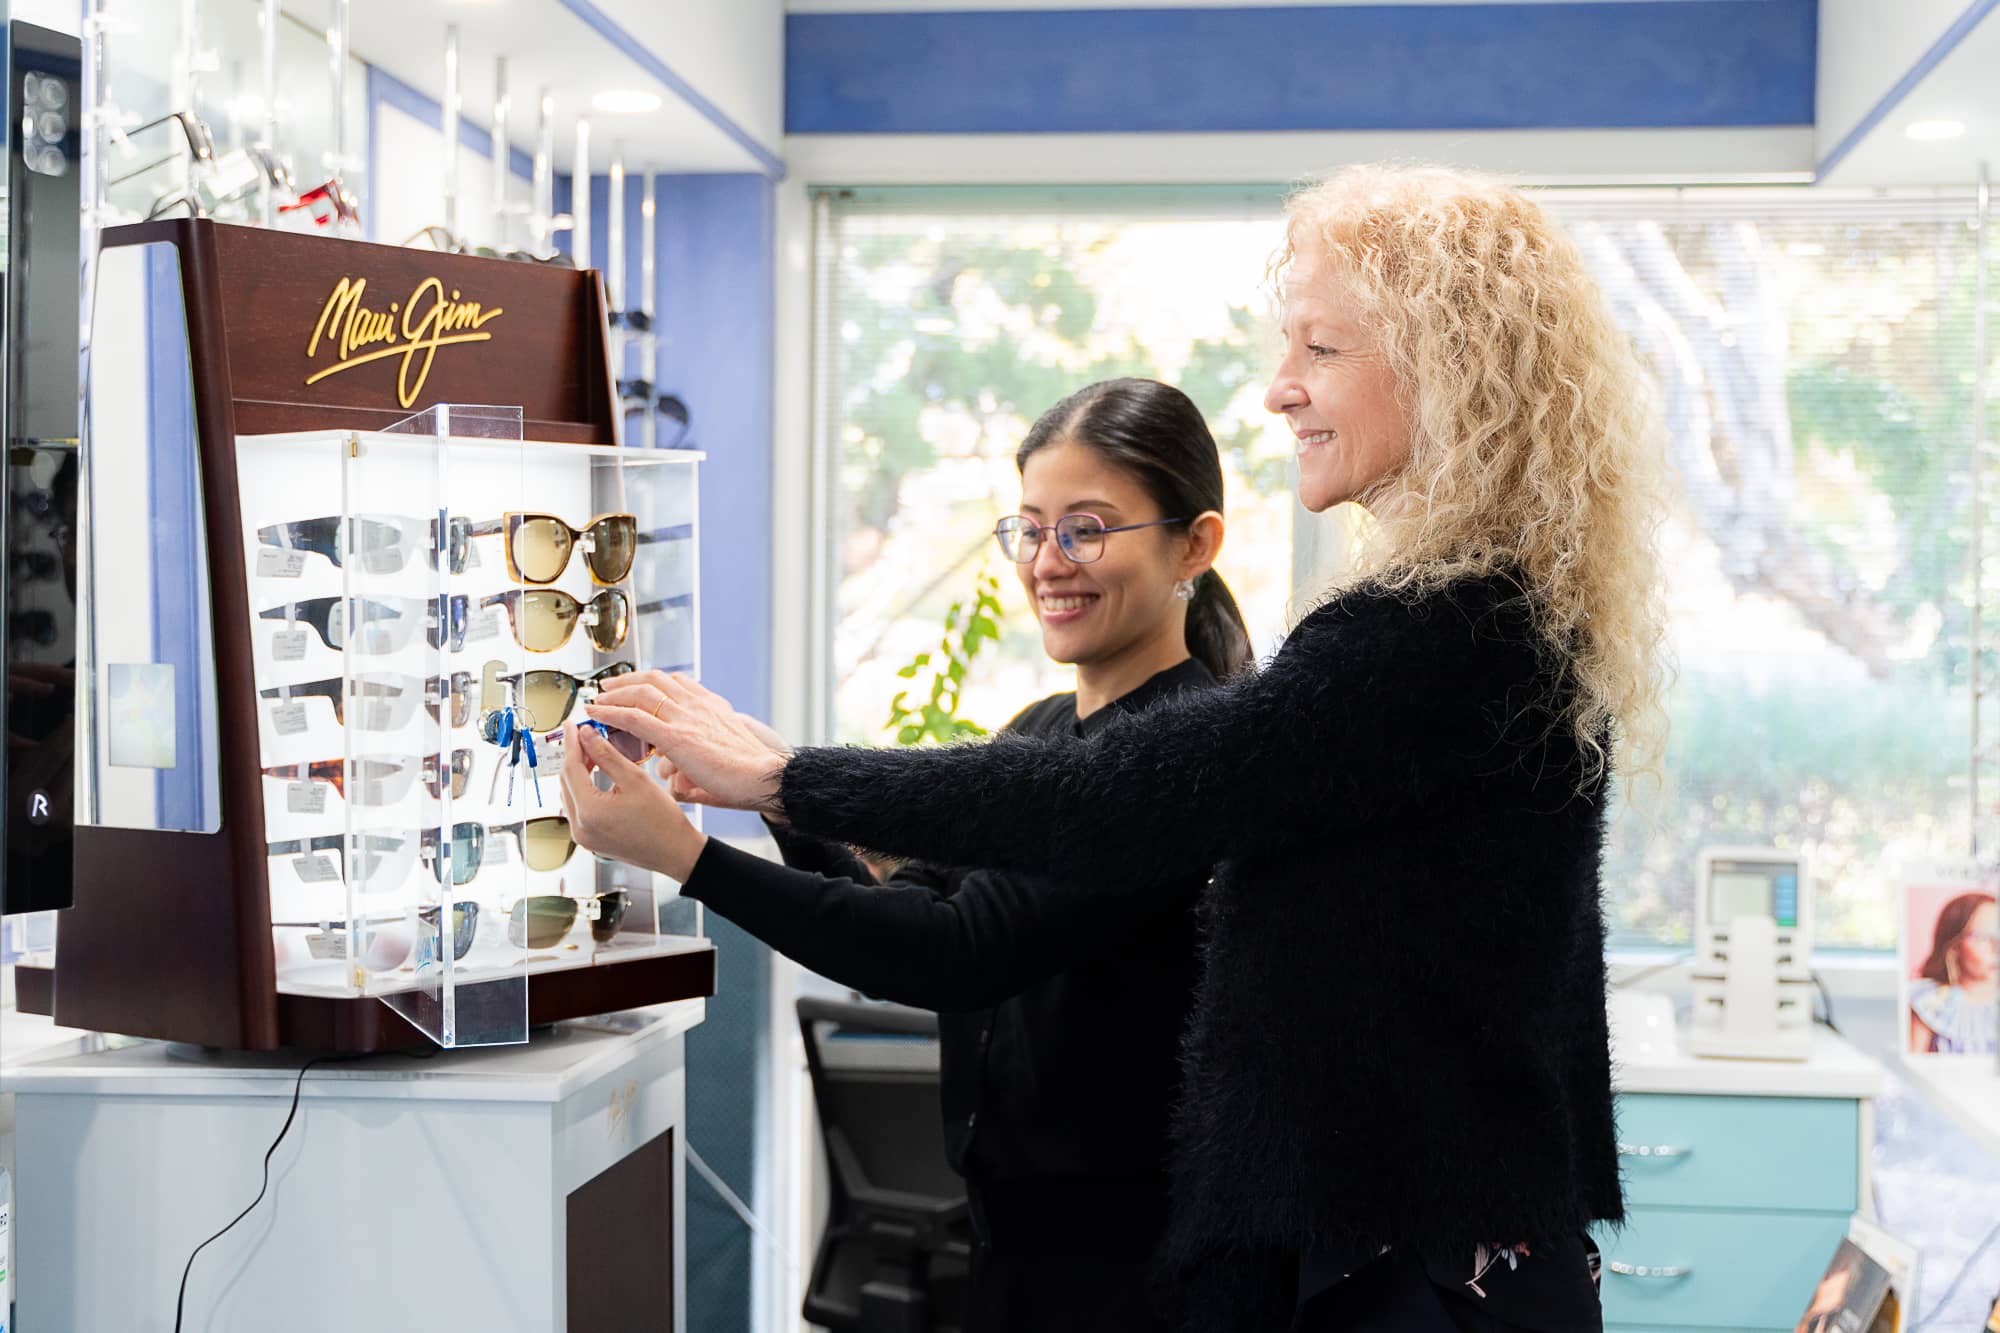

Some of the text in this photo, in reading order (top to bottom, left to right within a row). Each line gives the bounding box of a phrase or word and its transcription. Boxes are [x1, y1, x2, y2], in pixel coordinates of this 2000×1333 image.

[307, 276, 503, 408] Maui Jim
[32, 793, 49, 817] R
